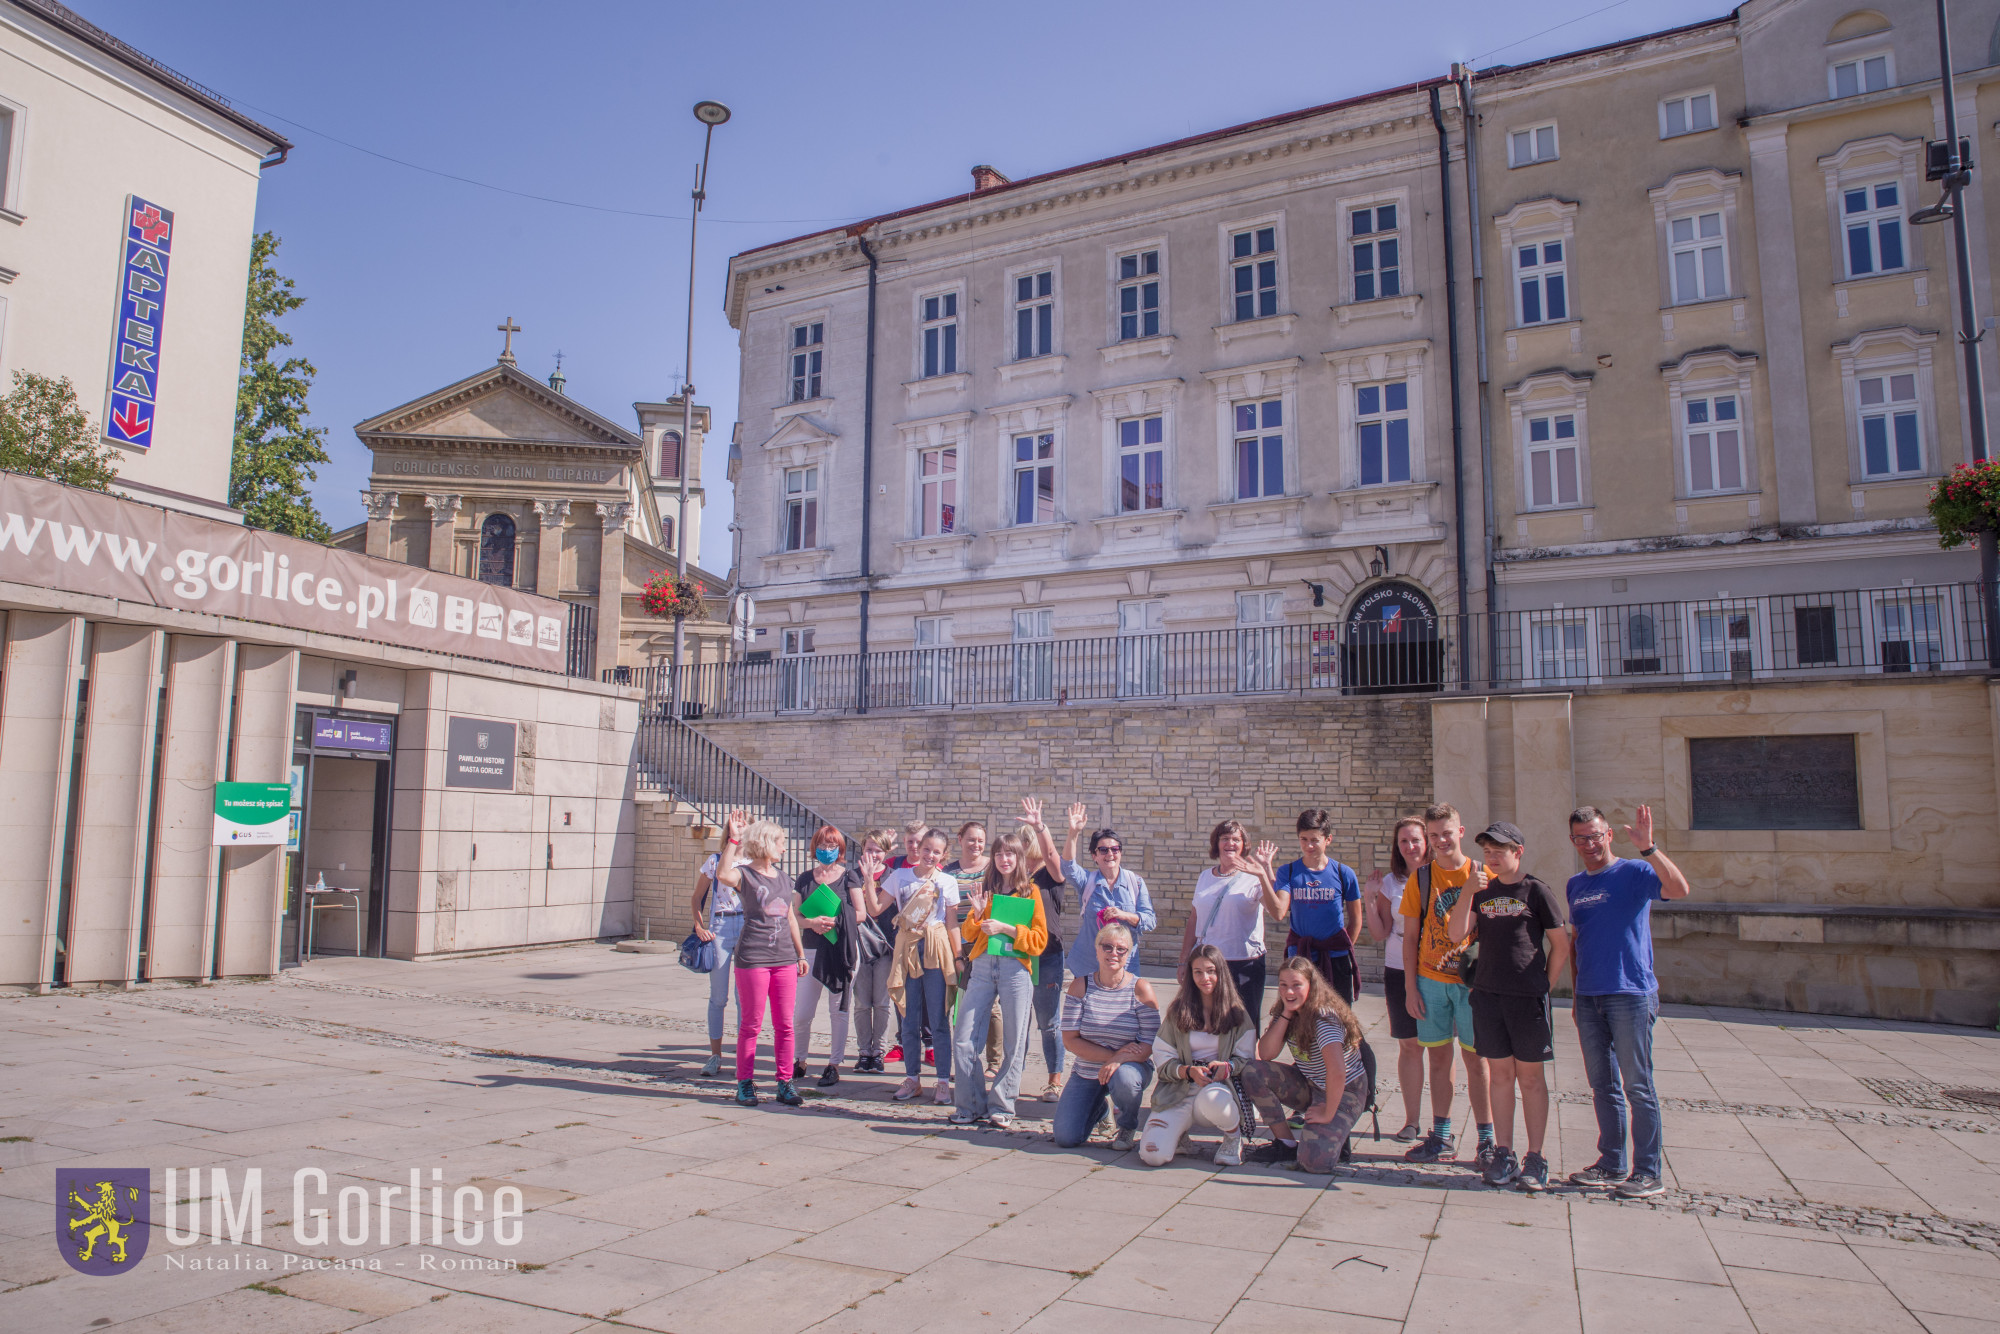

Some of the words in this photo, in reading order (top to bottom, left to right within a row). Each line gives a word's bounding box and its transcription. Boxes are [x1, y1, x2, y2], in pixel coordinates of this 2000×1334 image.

[116, 248, 164, 398] APTEKA
[393, 461, 480, 476] GORLICENSES
[492, 465, 537, 479] VIRGINI
[546, 468, 606, 482] DEIPARAE
[0, 512, 397, 629] www.gorlice.pl
[1352, 612, 1363, 633] DOM
[1360, 589, 1393, 612] POLSKO
[458, 754, 483, 763] PAWILON
[483, 756, 505, 765] HISTORII
[459, 765, 479, 773] MIASTA
[480, 767, 503, 775] GORLICE
[224, 799, 232, 807] Tu
[233, 799, 255, 807] możesz
[256, 799, 265, 808] się
[265, 799, 284, 808] spisać
[1293, 887, 1336, 900] HOLLISTER
[1574, 893, 1604, 905] Babolat
[1495, 903, 1508, 913] THE
